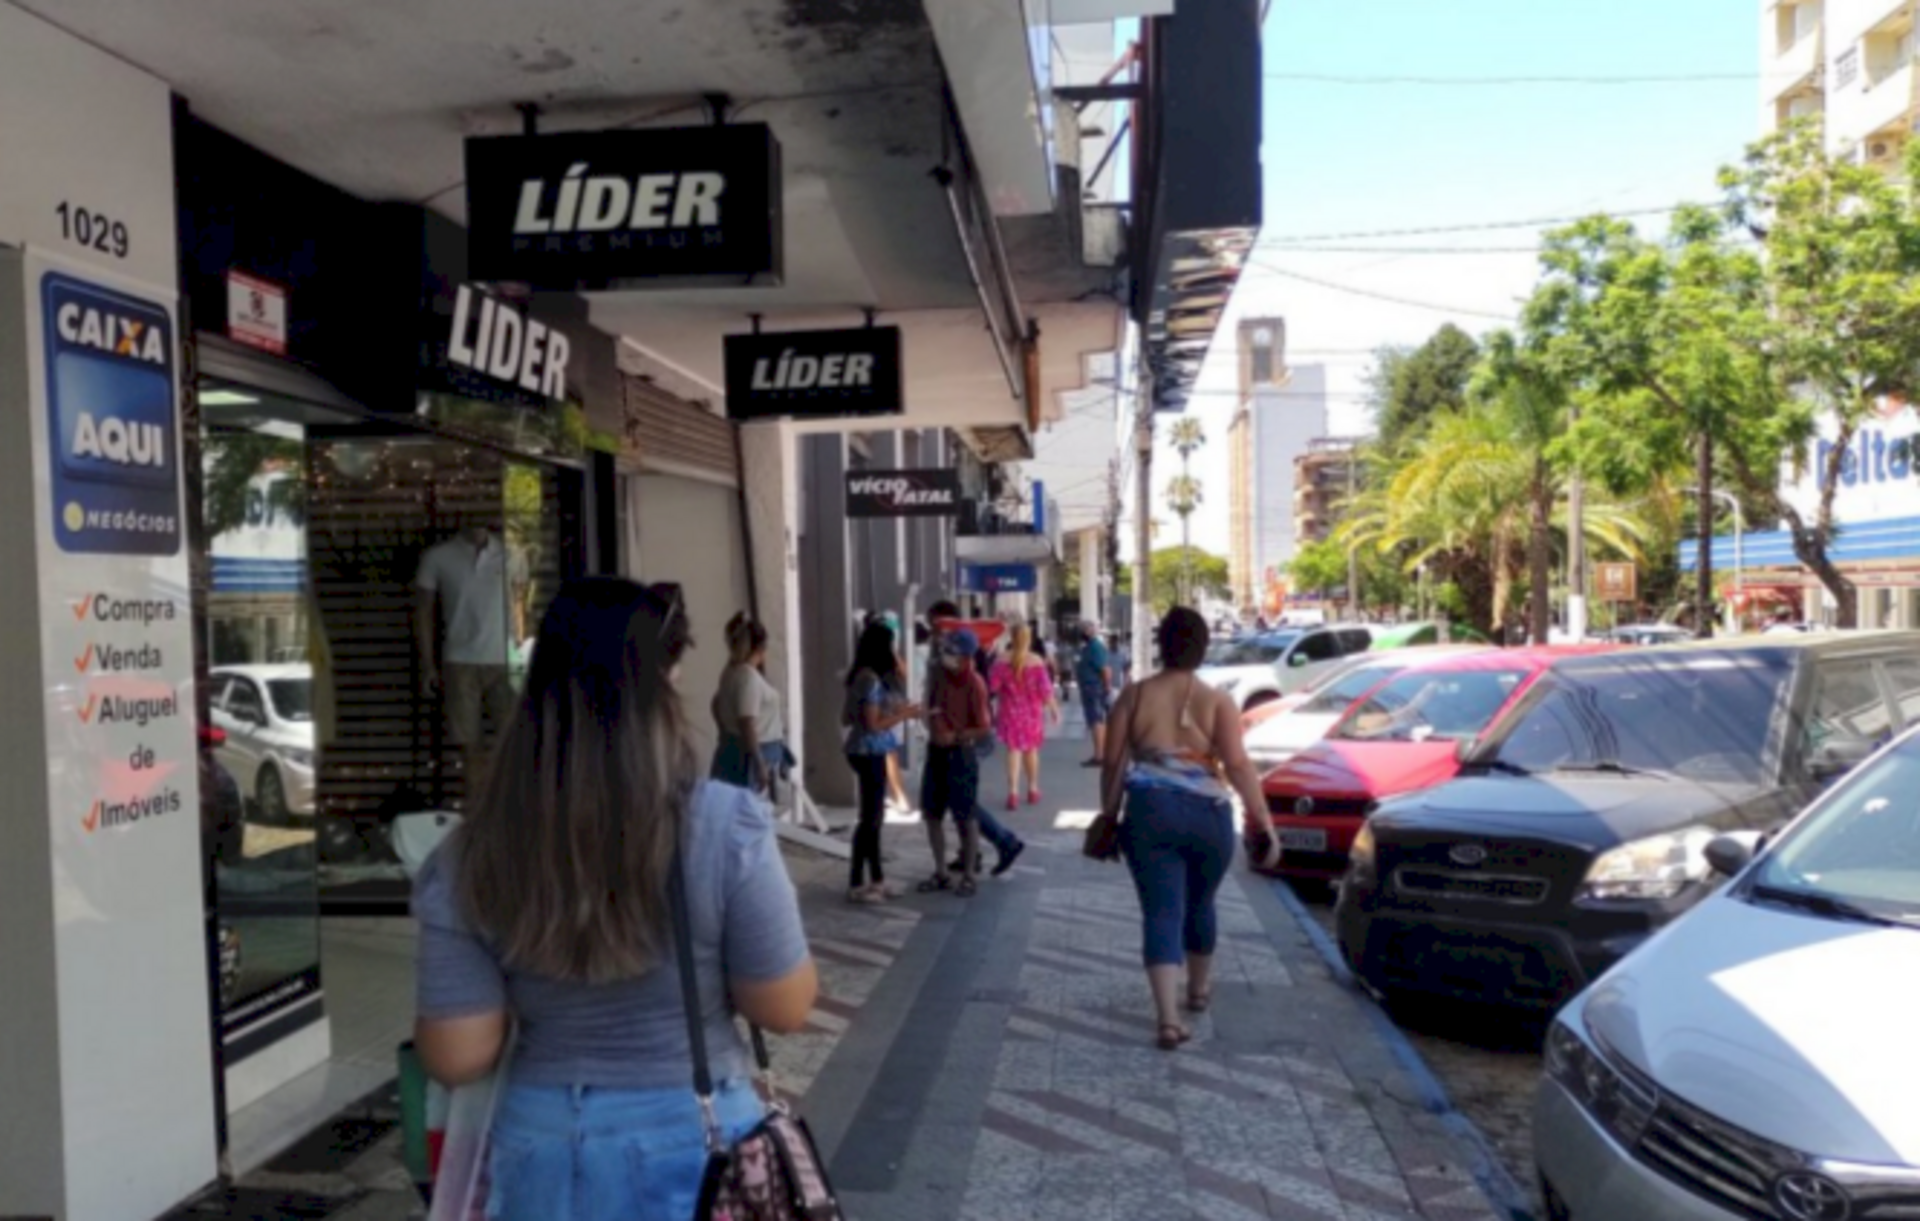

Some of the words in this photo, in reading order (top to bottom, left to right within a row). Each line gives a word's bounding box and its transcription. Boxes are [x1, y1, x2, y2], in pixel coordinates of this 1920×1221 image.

[513, 162, 725, 233] LÍDER
[56, 200, 129, 258] 1029
[57, 302, 164, 364] CAIXA
[751, 347, 873, 390] LÍDER
[72, 411, 164, 466] AQUI
[86, 510, 175, 533] NEGÓCIOS
[94, 593, 176, 626] Compra
[94, 644, 163, 671] Venda
[98, 690, 178, 726] Aluguel
[129, 744, 155, 770] de
[100, 787, 181, 828] Imóveis
